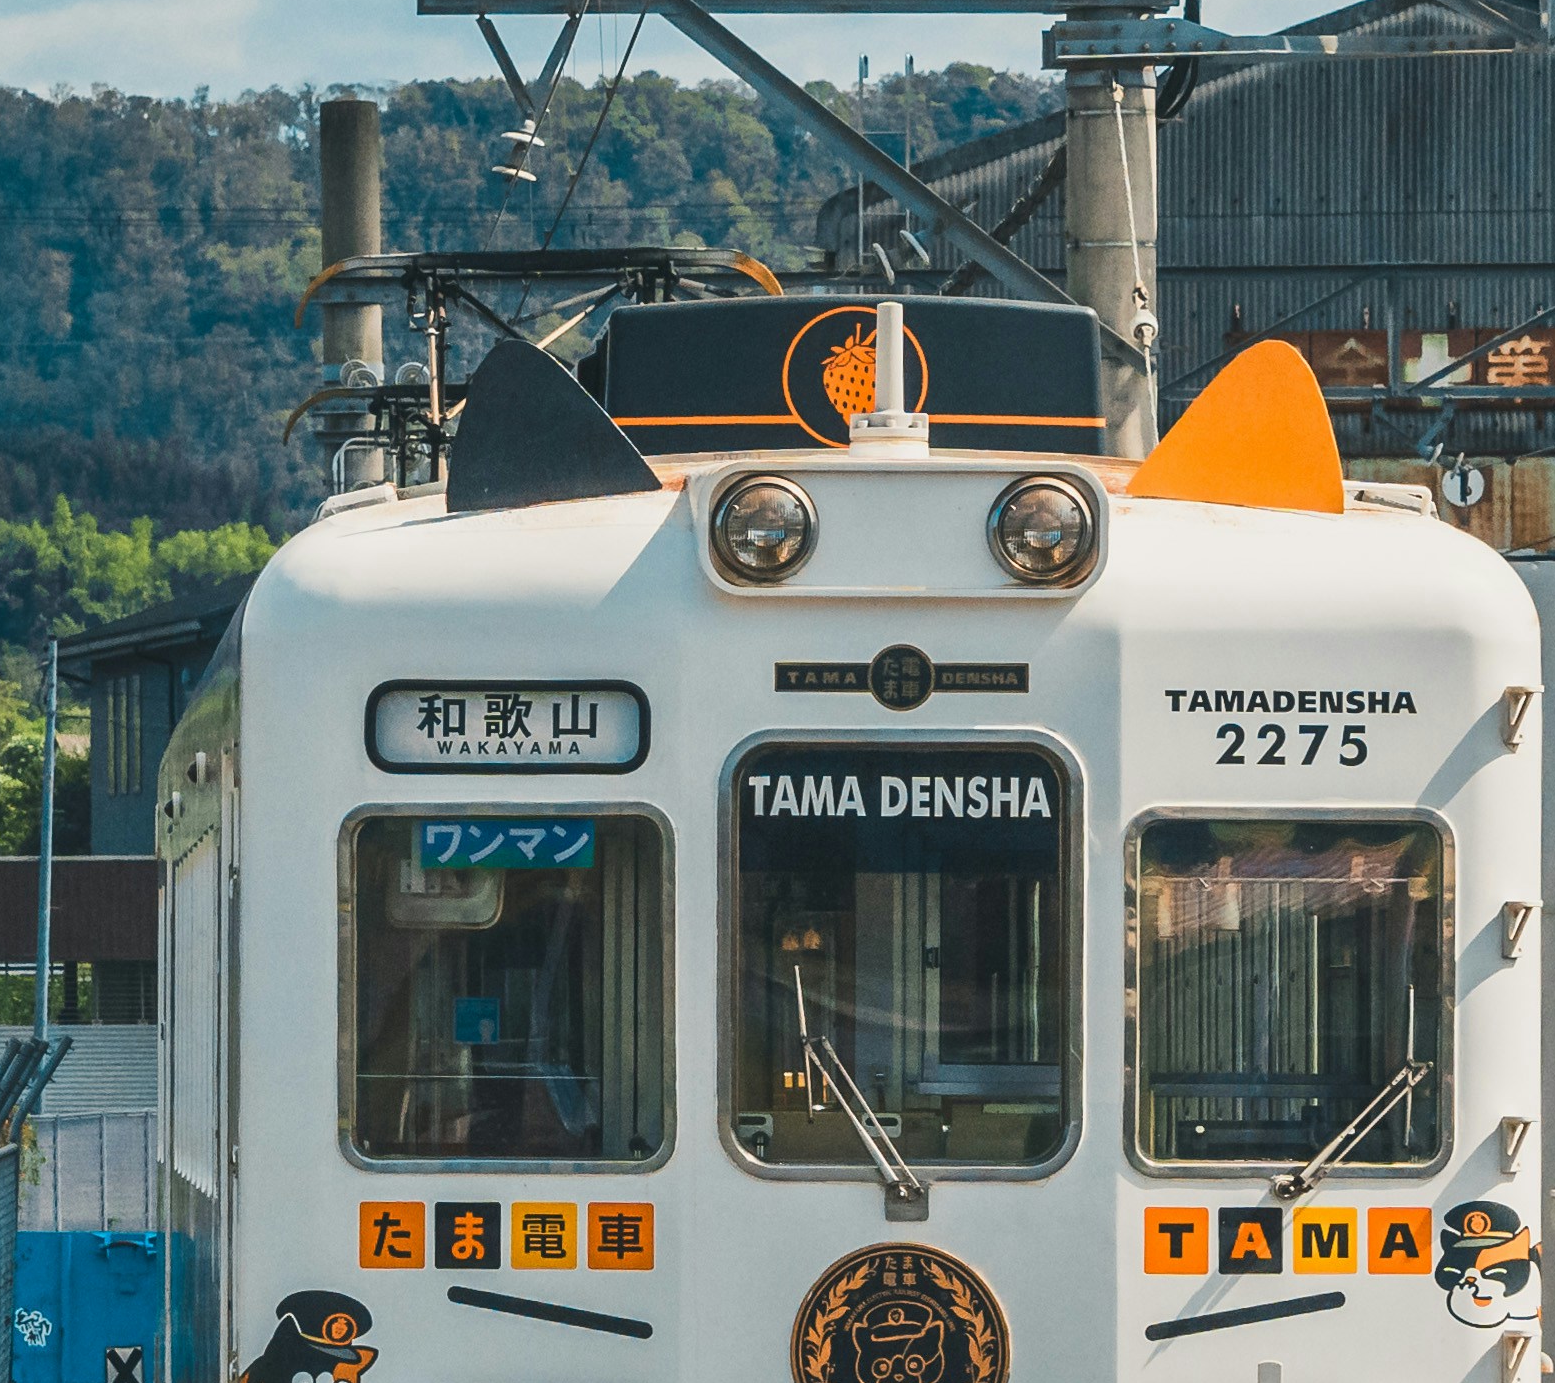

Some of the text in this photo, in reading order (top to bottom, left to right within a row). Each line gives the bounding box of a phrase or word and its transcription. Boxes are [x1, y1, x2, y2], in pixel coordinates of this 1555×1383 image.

[787, 671, 1019, 685] TAMA DENSHA
[417, 694, 598, 739] 和歌山
[1164, 689, 1417, 714] TAMADENSHA
[437, 740, 581, 755] WAKAYAMA
[1216, 723, 1369, 767] 2275
[749, 775, 1051, 818] TAMA DENSHA
[426, 824, 590, 864] ワンマン
[373, 1211, 643, 1261] たま電車
[1158, 1222, 1420, 1260] TAMA
